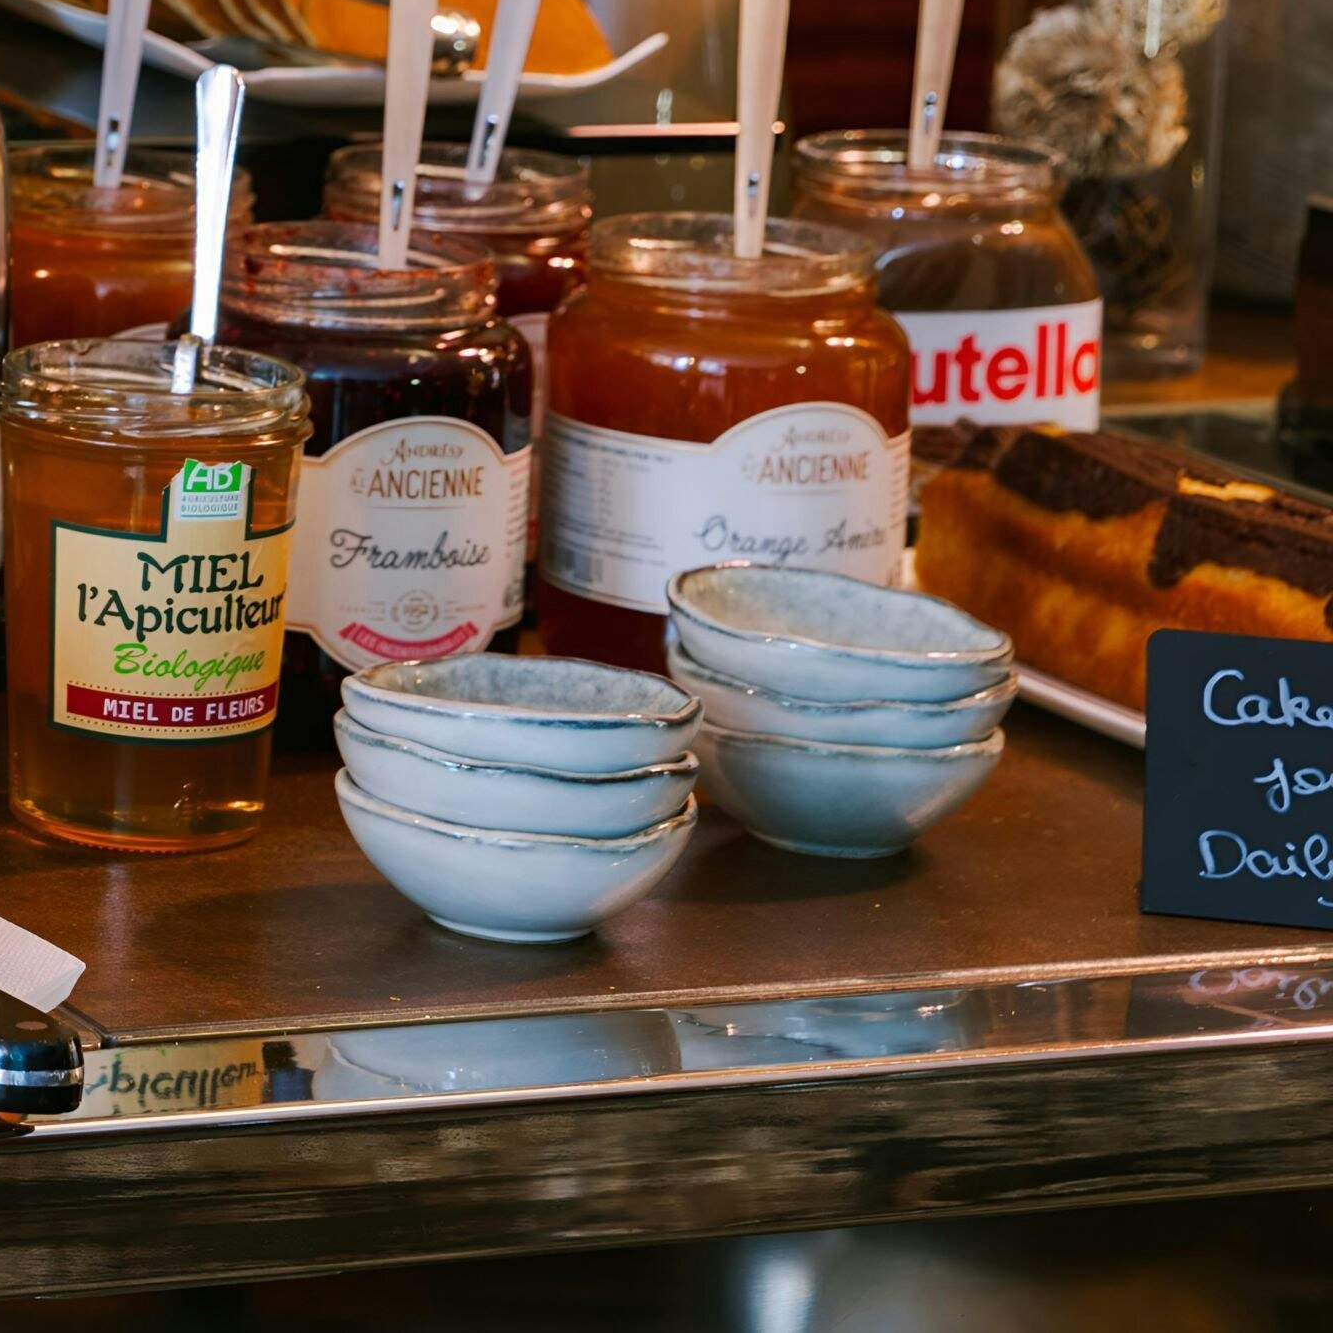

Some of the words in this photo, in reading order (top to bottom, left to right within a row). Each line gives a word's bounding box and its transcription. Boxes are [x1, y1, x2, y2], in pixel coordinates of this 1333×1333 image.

[911, 322, 1099, 405] utella
[186, 461, 233, 490] AB
[368, 465, 484, 498] ANCIENNE
[330, 528, 491, 571] Framboise
[693, 513, 809, 566] Orange
[137, 551, 264, 593] MIEL
[77, 583, 284, 641] l'Apiculteur
[113, 643, 265, 692] Biologique
[103, 698, 158, 721] MIEL
[171, 706, 194, 722] DE
[205, 695, 265, 721] FLEURS
